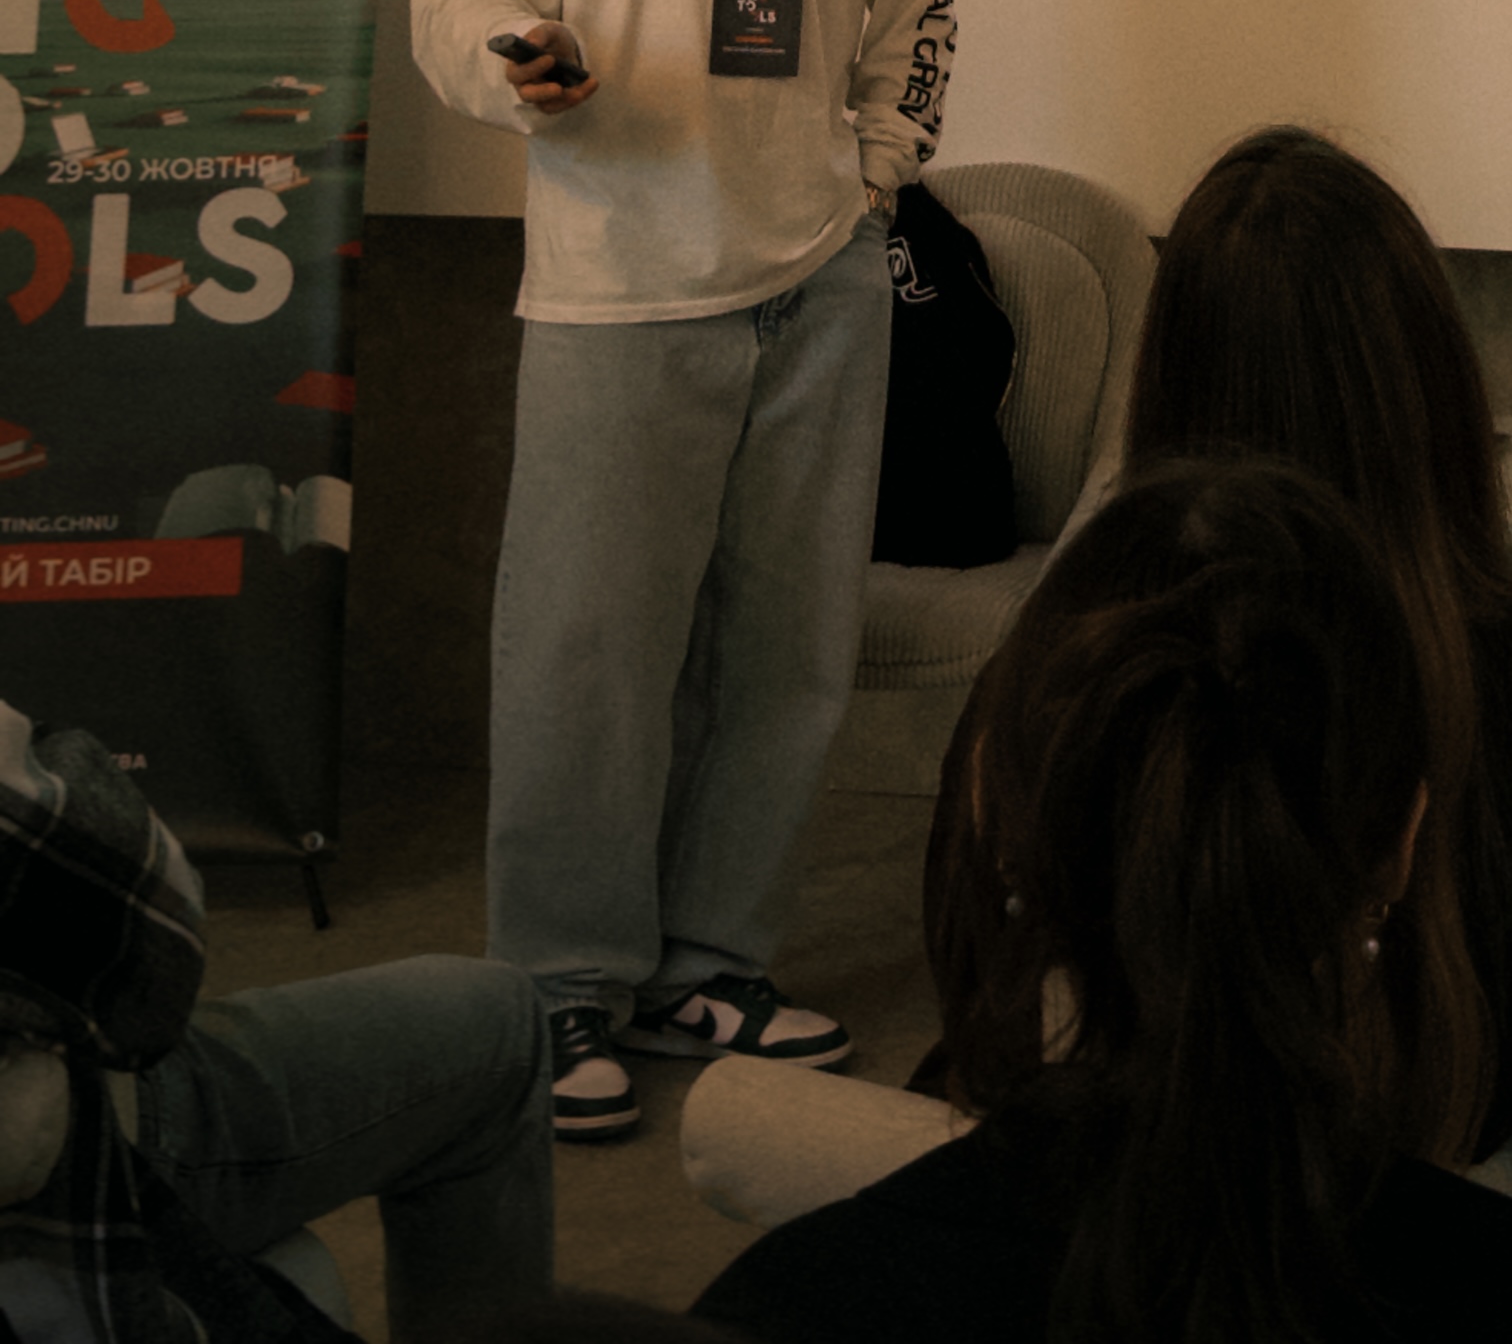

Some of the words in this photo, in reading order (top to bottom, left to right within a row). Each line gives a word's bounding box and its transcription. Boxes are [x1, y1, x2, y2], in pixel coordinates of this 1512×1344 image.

[46, 157, 132, 185] 29-30
[138, 154, 279, 183] ЖОВТНЯ
[38, 555, 153, 587] ТАБІР
